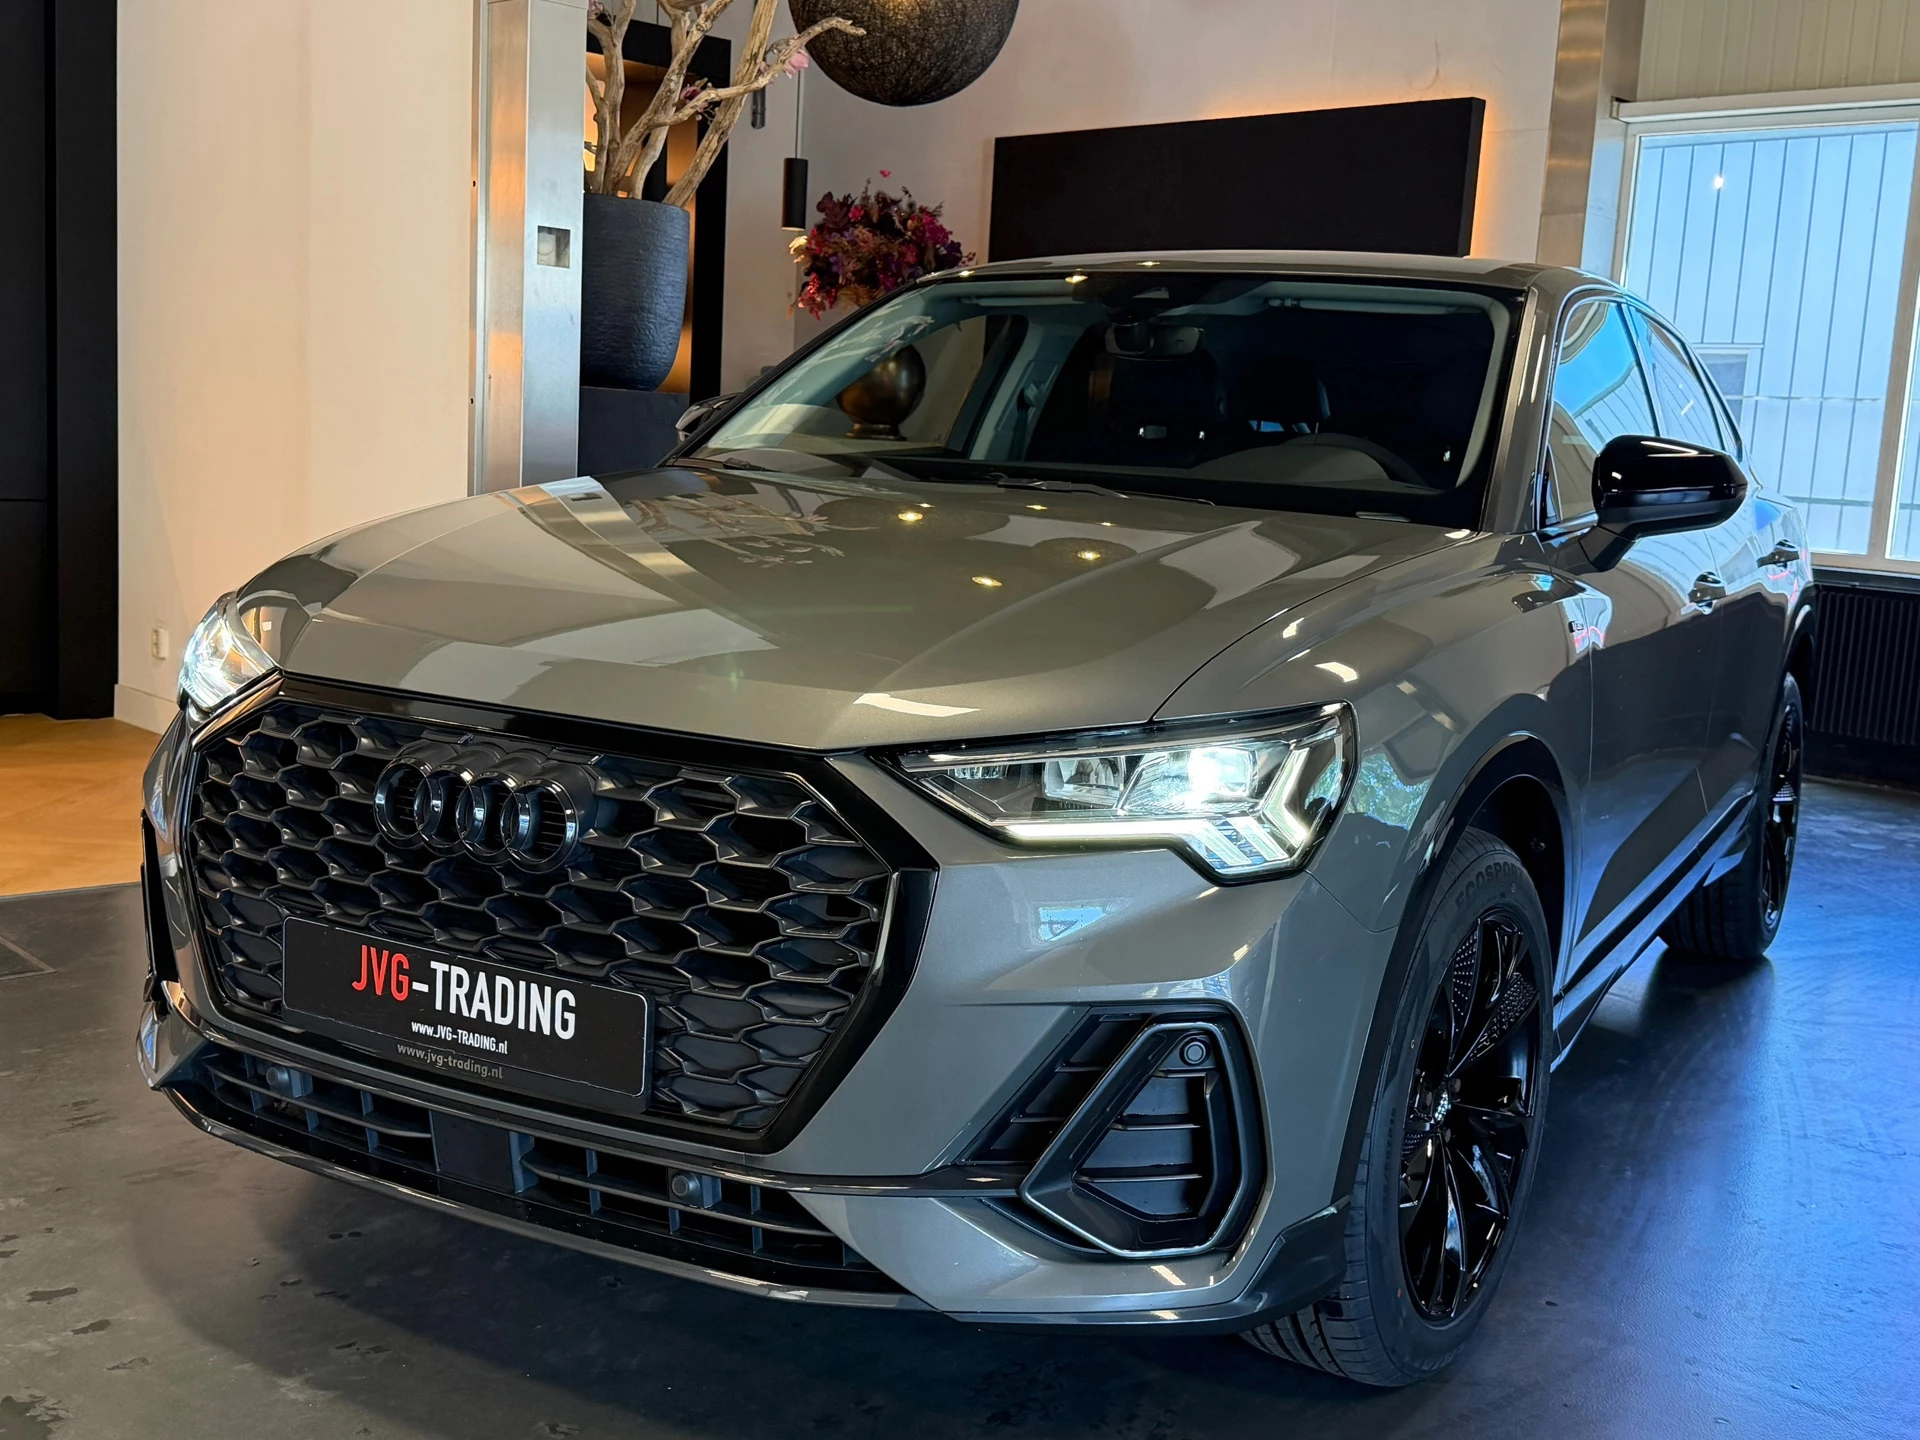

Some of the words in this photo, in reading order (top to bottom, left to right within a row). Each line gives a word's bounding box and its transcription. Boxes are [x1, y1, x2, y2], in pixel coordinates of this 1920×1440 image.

[351, 945, 576, 1040] JVG-TRADING
[411, 1021, 508, 1055] www.JVG-TRADING.nl
[396, 1043, 503, 1079] www.jvg-trading.nl
